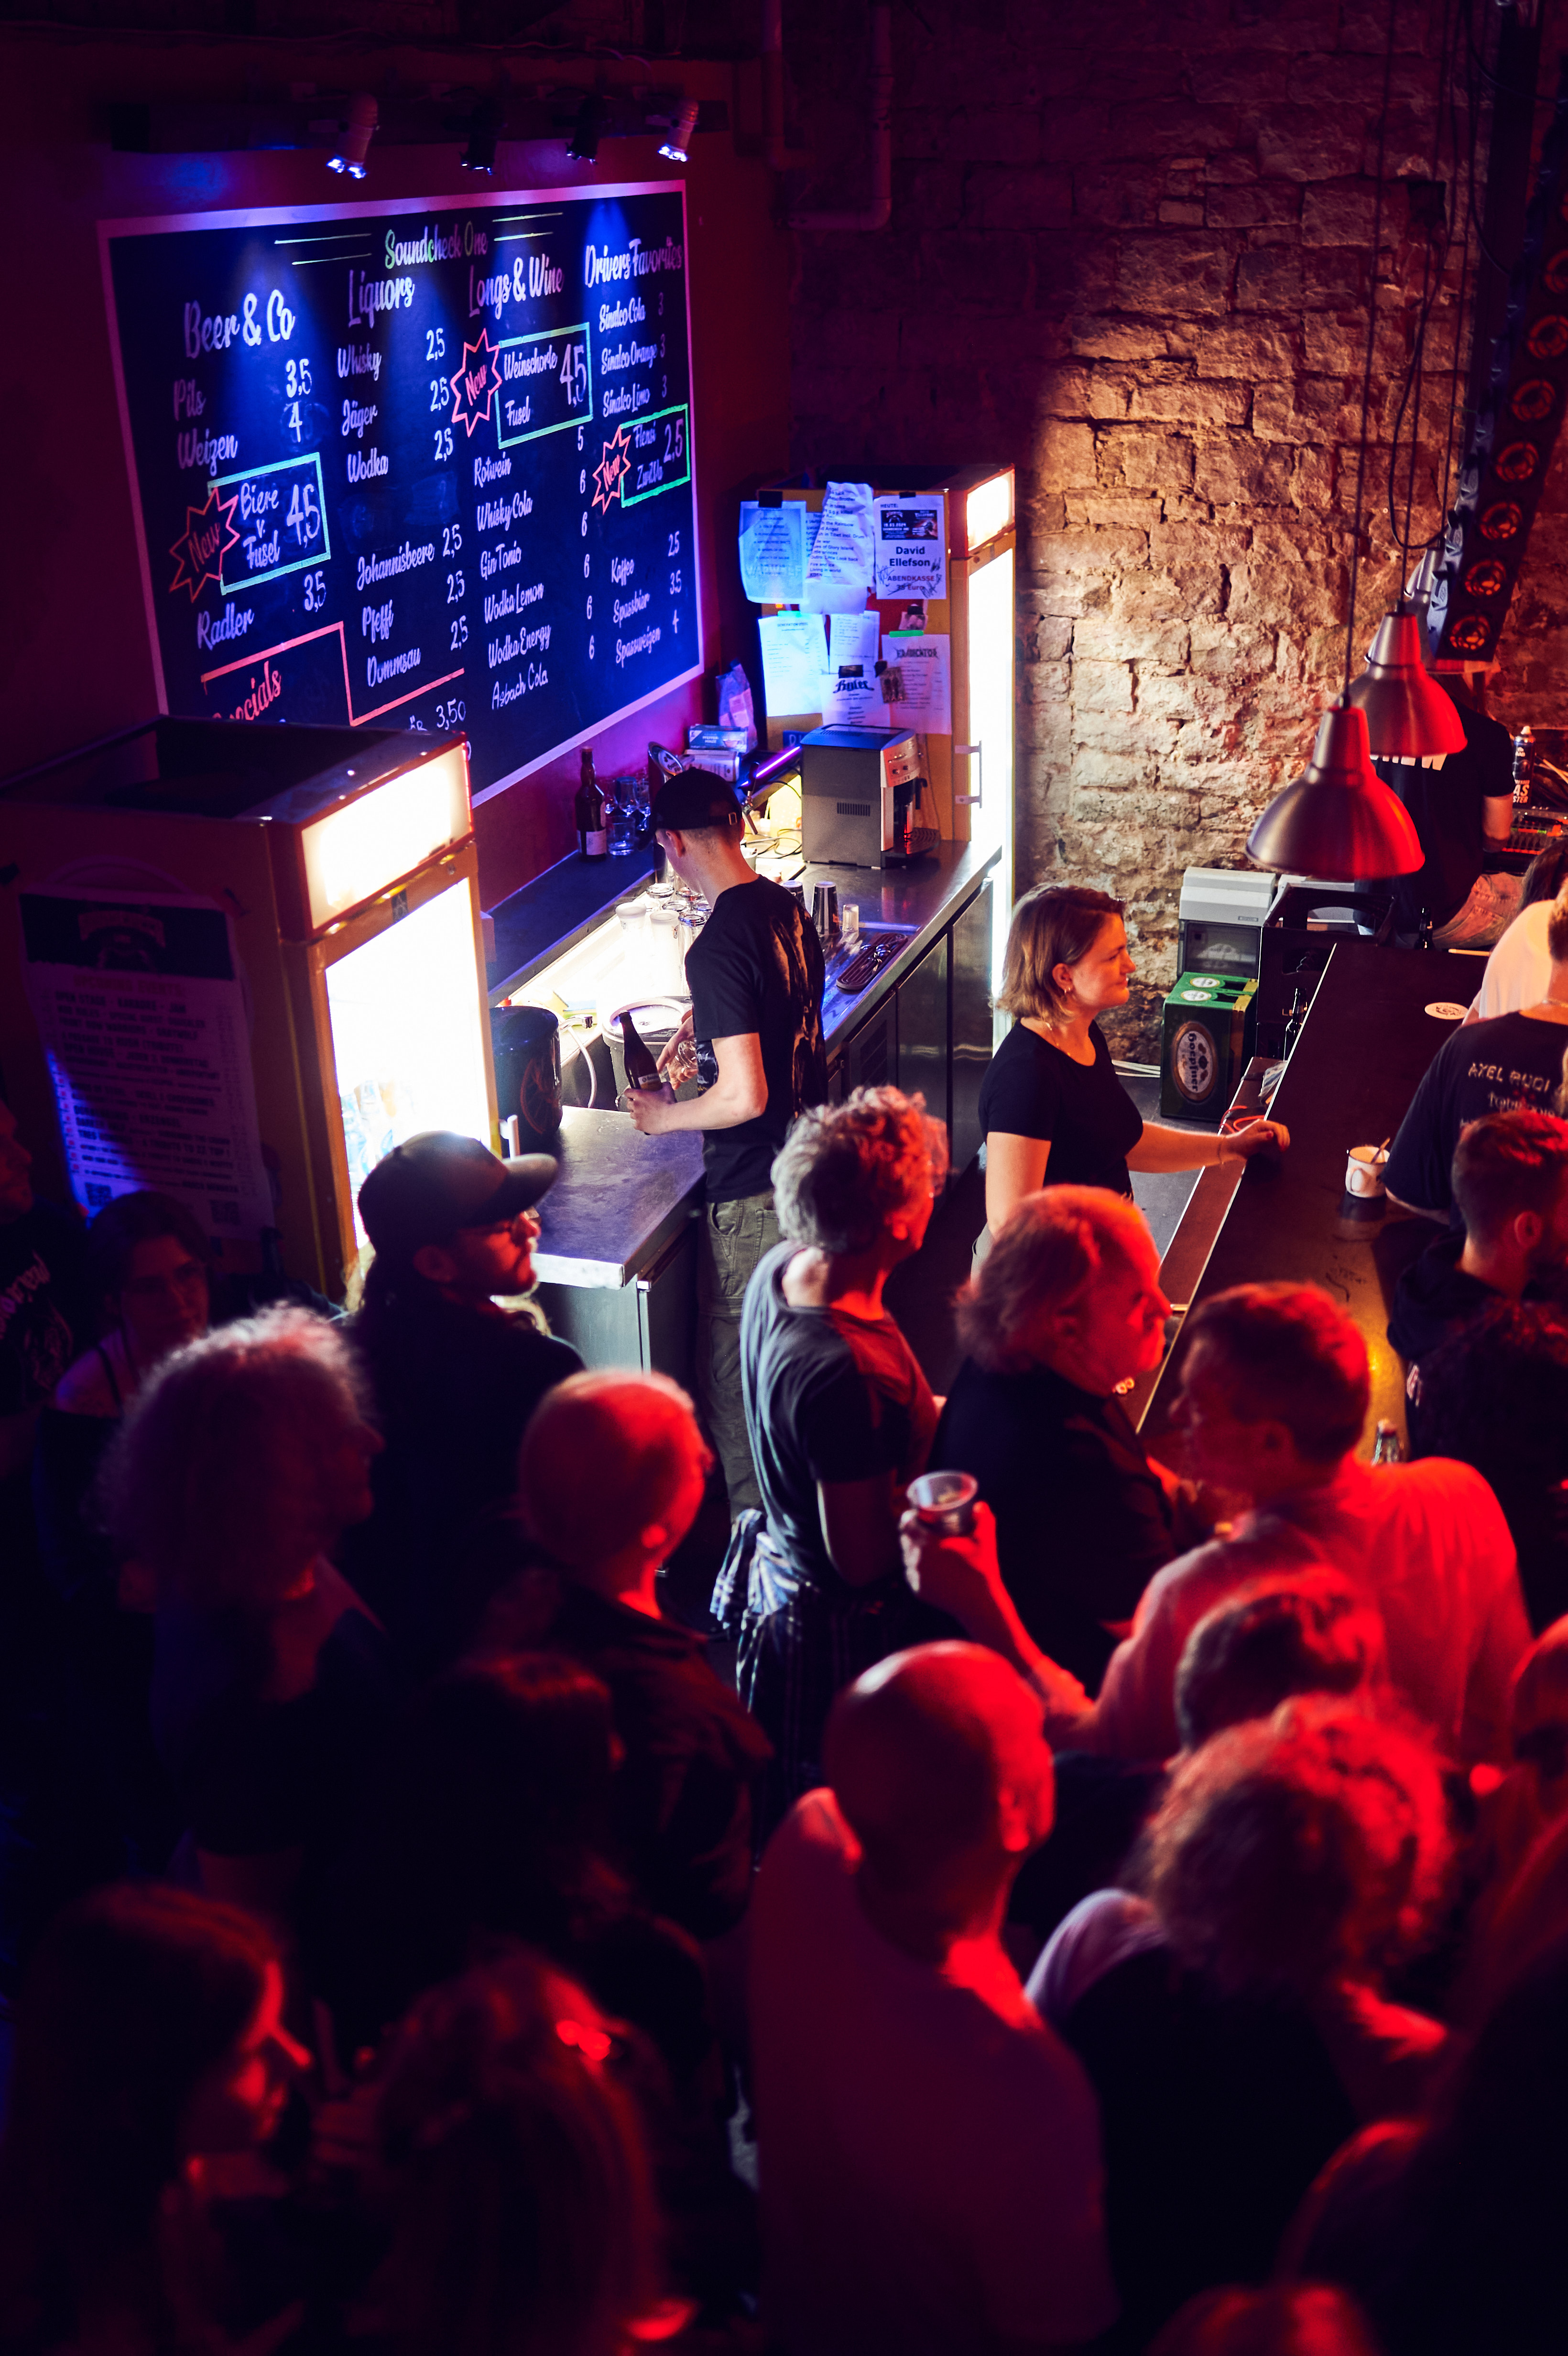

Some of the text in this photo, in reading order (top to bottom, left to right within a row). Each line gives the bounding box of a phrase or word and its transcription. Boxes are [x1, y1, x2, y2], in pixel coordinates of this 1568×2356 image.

[384, 221, 488, 269] Soundcheck One
[585, 237, 682, 287] Drivers Favorites
[348, 269, 414, 327] Liquors
[469, 253, 564, 319] Longs & Wine
[599, 292, 664, 333] Sinalco Cola 3
[184, 289, 295, 358] Beer & Co
[338, 327, 445, 381] Whisky 2,5
[503, 344, 557, 382] Weinschorle
[560, 344, 587, 408] 4,5
[601, 333, 666, 375] Sinalco Orange 3
[174, 358, 312, 421] Pils 3,5
[342, 377, 450, 438] Jäger 2,5
[466, 363, 487, 406] New
[504, 395, 530, 427] Fusel
[603, 386, 631, 418] Sinalco
[662, 375, 667, 397] 3
[178, 401, 302, 476] Weizen 4
[347, 427, 453, 482] Wodka 2,5
[474, 426, 584, 488] Rotwein 5
[664, 418, 683, 463] 2,5
[602, 454, 621, 492] New
[240, 482, 279, 520] Biere
[286, 484, 321, 548] 4,5
[477, 469, 586, 532] Whisky Cola 6
[188, 522, 221, 573] New
[242, 530, 280, 569] Fusel
[356, 524, 462, 591] Johannisbeere 2,5
[480, 512, 588, 580] Gin Tonic 6
[611, 557, 634, 586] Kaffee
[890, 558, 930, 567] Ellefson
[896, 546, 926, 555] David
[197, 570, 326, 650] Radler 3,5
[362, 570, 465, 644] Pfeffi 2,5
[484, 553, 590, 624] Wodka Lemon 6
[613, 589, 650, 628] Spassbier
[450, 615, 468, 651] 2,5
[488, 595, 593, 669] Wodka Energy 6
[616, 609, 679, 668] Spassweizen 4
[212, 661, 281, 720] ecials
[492, 635, 595, 710] Asbach Cola 6
[436, 698, 466, 731] 3,50
[1468, 1062, 1550, 1092] AXEL RUDI
